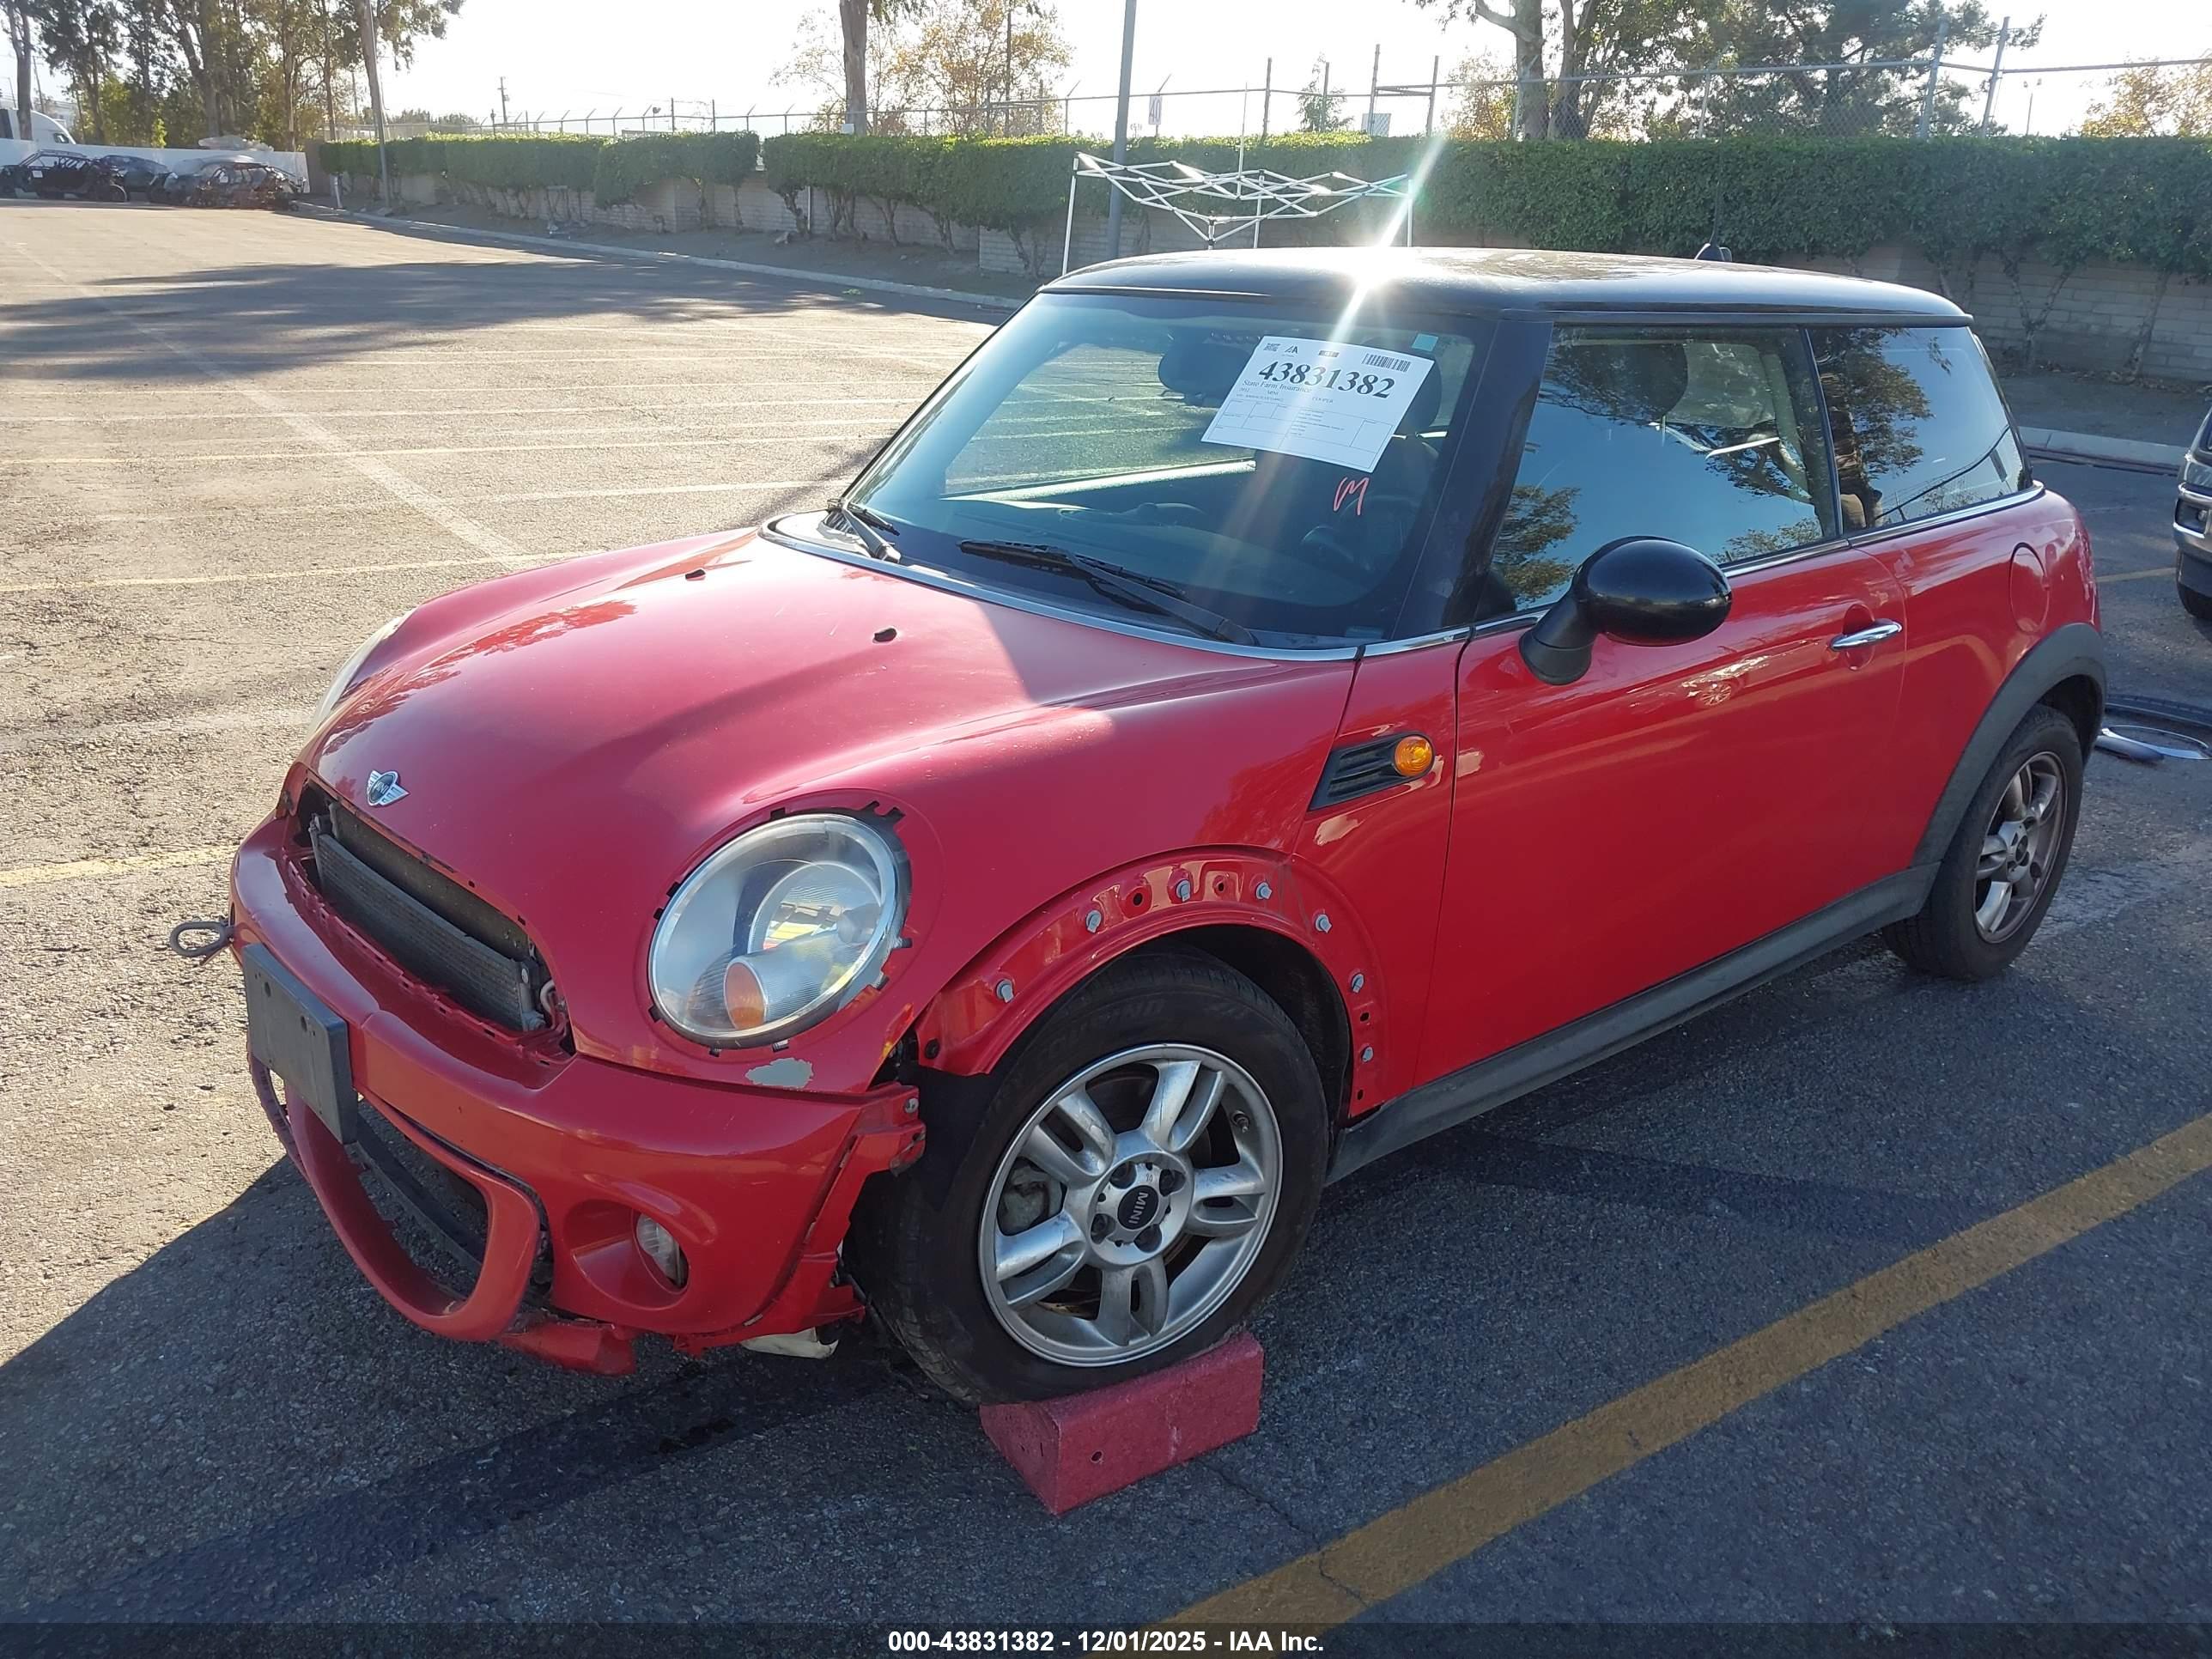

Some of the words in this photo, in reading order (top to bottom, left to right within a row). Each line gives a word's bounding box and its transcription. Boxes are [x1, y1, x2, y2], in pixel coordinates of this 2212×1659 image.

[1243, 379, 1259, 387] State
[1261, 380, 1278, 389] Farm
[1279, 383, 1312, 393] Insurance
[1258, 361, 1395, 399] 43831382
[1127, 1191, 1149, 1224] MINI
